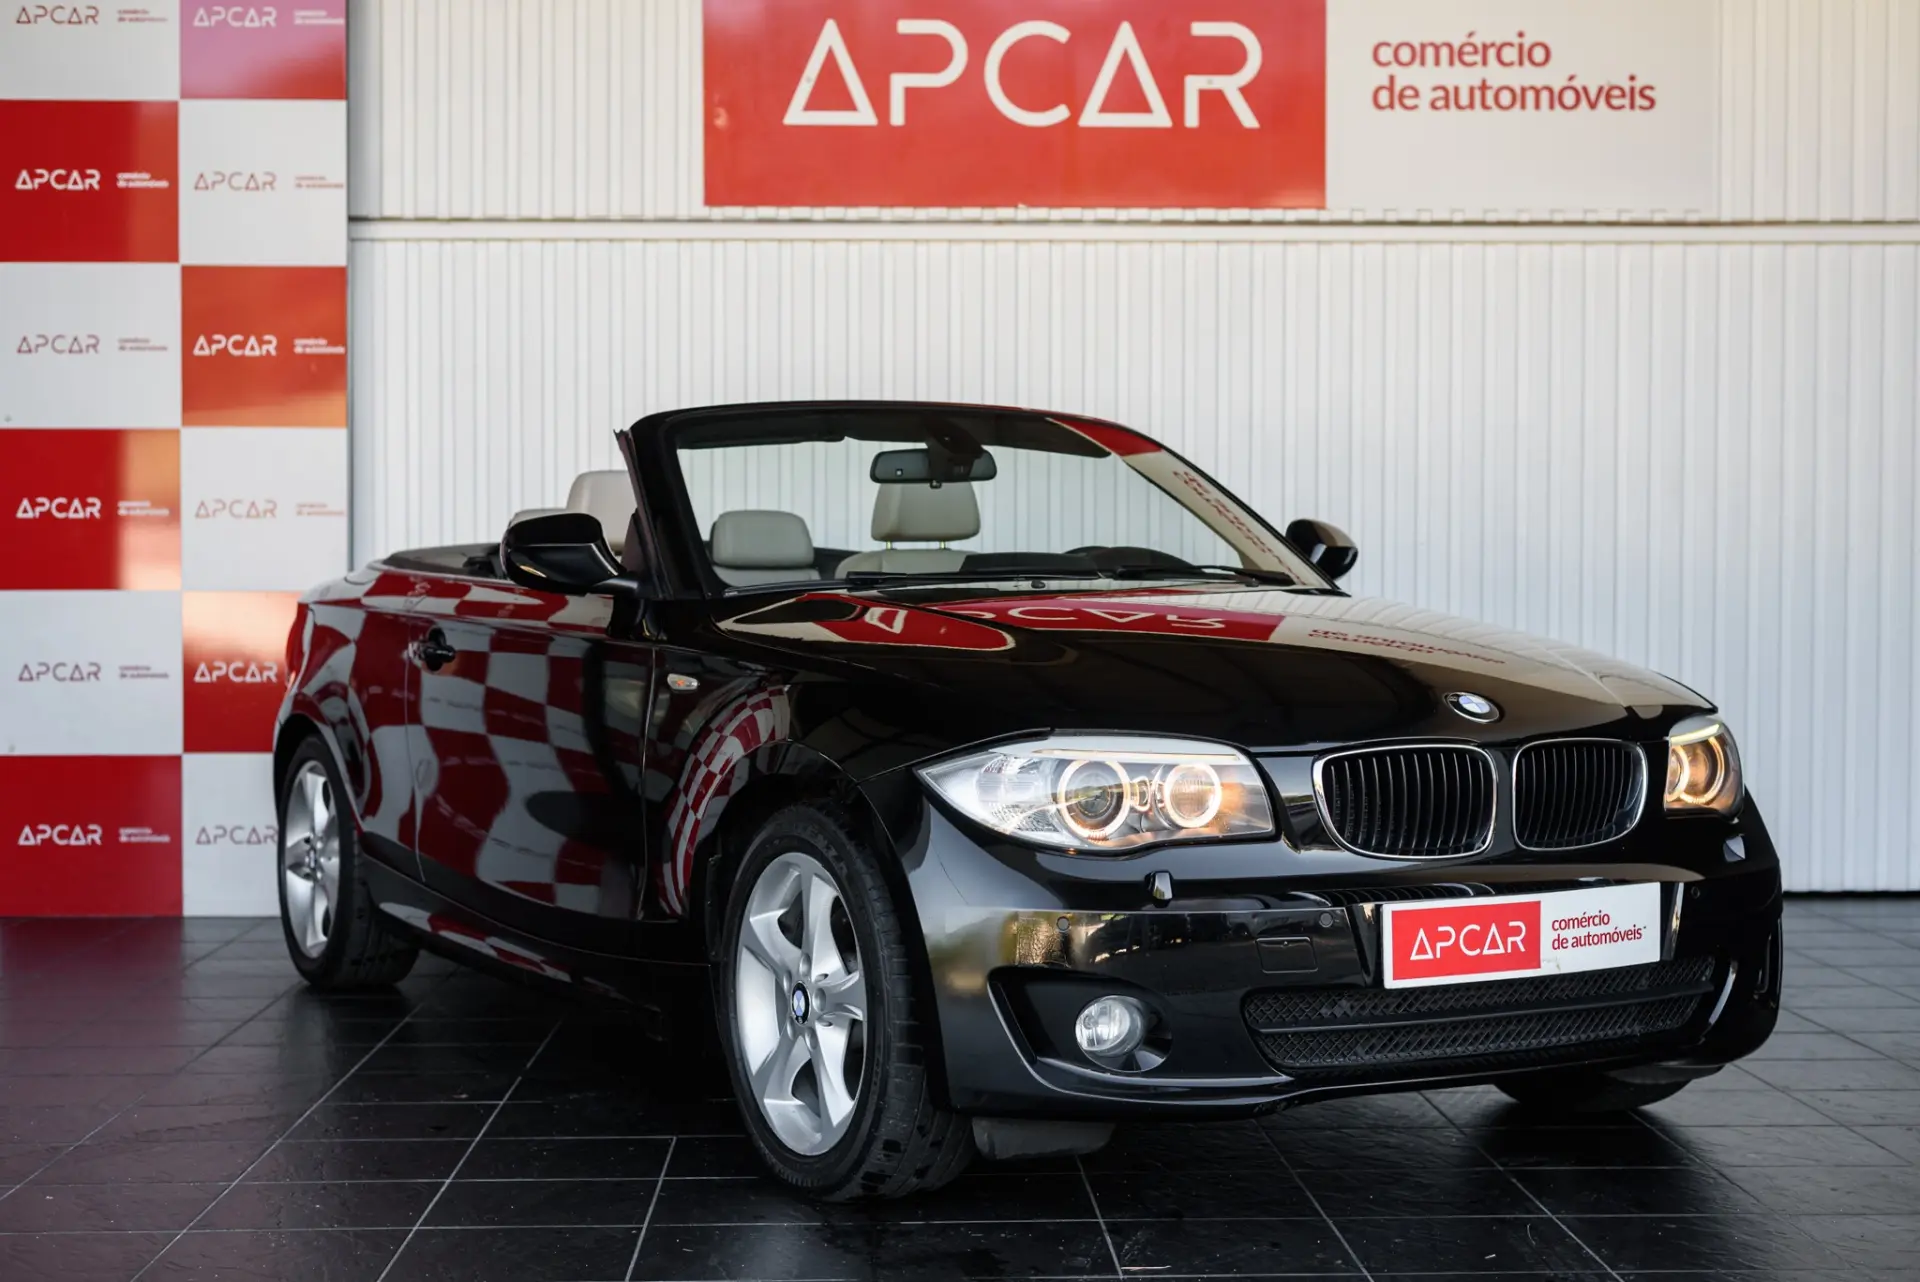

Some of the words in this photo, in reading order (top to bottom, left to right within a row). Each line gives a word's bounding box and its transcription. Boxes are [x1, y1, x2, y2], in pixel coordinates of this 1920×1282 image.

[16, 5, 99, 25] APCAR
[192, 6, 277, 28] APCAR
[1372, 30, 1551, 67] comércio
[783, 18, 1262, 128] APCAR
[1372, 74, 1420, 111] de
[1429, 74, 1656, 111] automóveis
[15, 169, 101, 191] APCAR
[194, 171, 277, 191] APCAR
[17, 334, 100, 354] APCAR
[193, 334, 278, 356] APCAR
[16, 497, 101, 519] APCAR
[195, 499, 277, 519] APCAR
[18, 662, 101, 682] APCAR
[193, 661, 278, 683] APCAR
[18, 824, 102, 845] APCAR
[195, 824, 279, 845] APCAR
[1551, 909, 1610, 932] comércio
[1410, 921, 1526, 960] APCAR
[1551, 933, 1568, 950] de
[1571, 924, 1642, 948] automóveis
